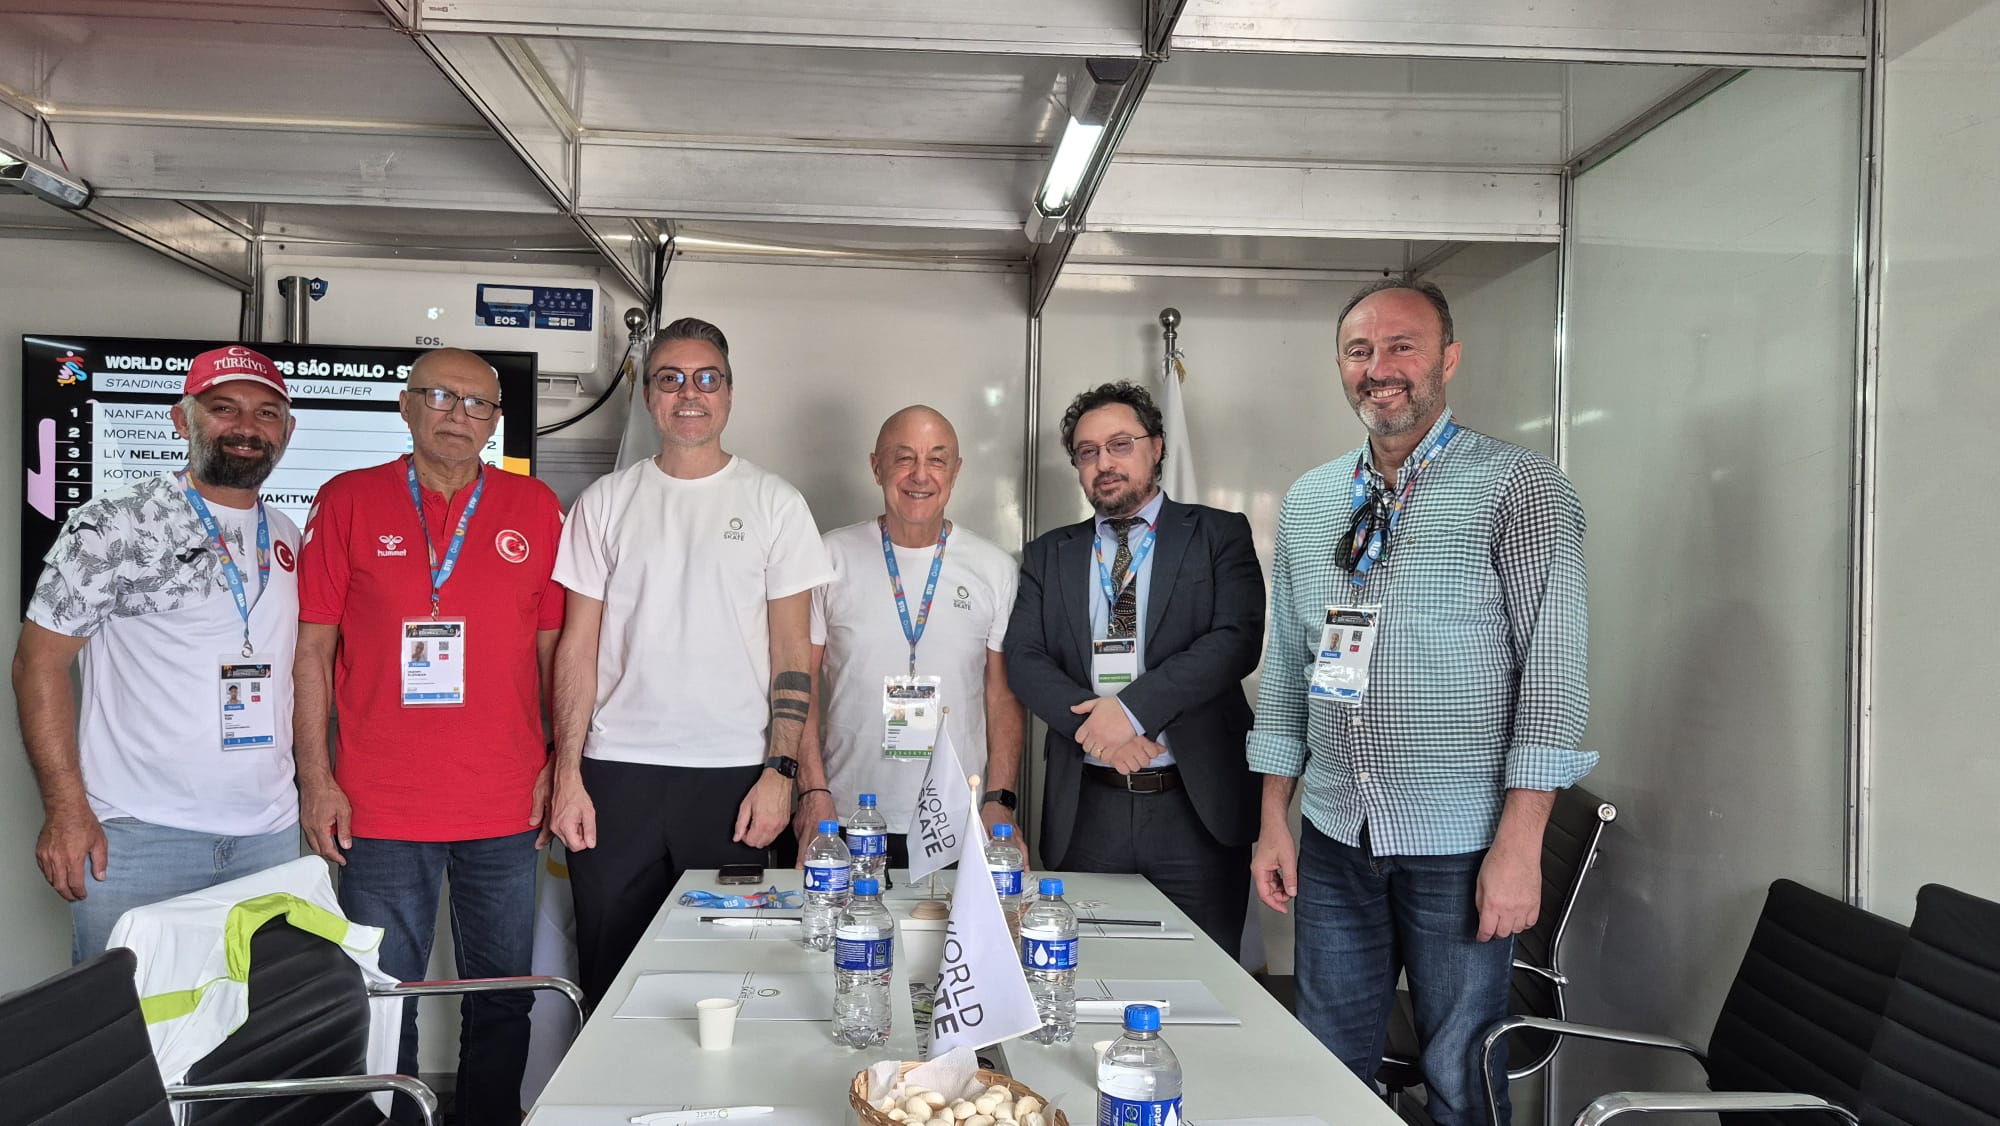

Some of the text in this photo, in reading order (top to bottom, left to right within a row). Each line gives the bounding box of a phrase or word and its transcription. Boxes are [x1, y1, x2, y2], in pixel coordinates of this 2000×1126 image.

[415, 336, 444, 346] EOS.
[105, 355, 162, 371] WORLD
[297, 359, 331, 377] SÃO
[333, 362, 385, 379] PAULO
[105, 378, 182, 390] STANDINGS
[302, 384, 373, 396] QUALIFIER
[70, 407, 79, 418] 1
[68, 427, 80, 438] 2
[103, 429, 167, 440] MORENA
[68, 447, 190, 461] 3 LIV NELEMA
[68, 467, 80, 478] 4
[68, 487, 80, 498] 5
[377, 549, 407, 557] hummel
[925, 778, 956, 848] WORLD
